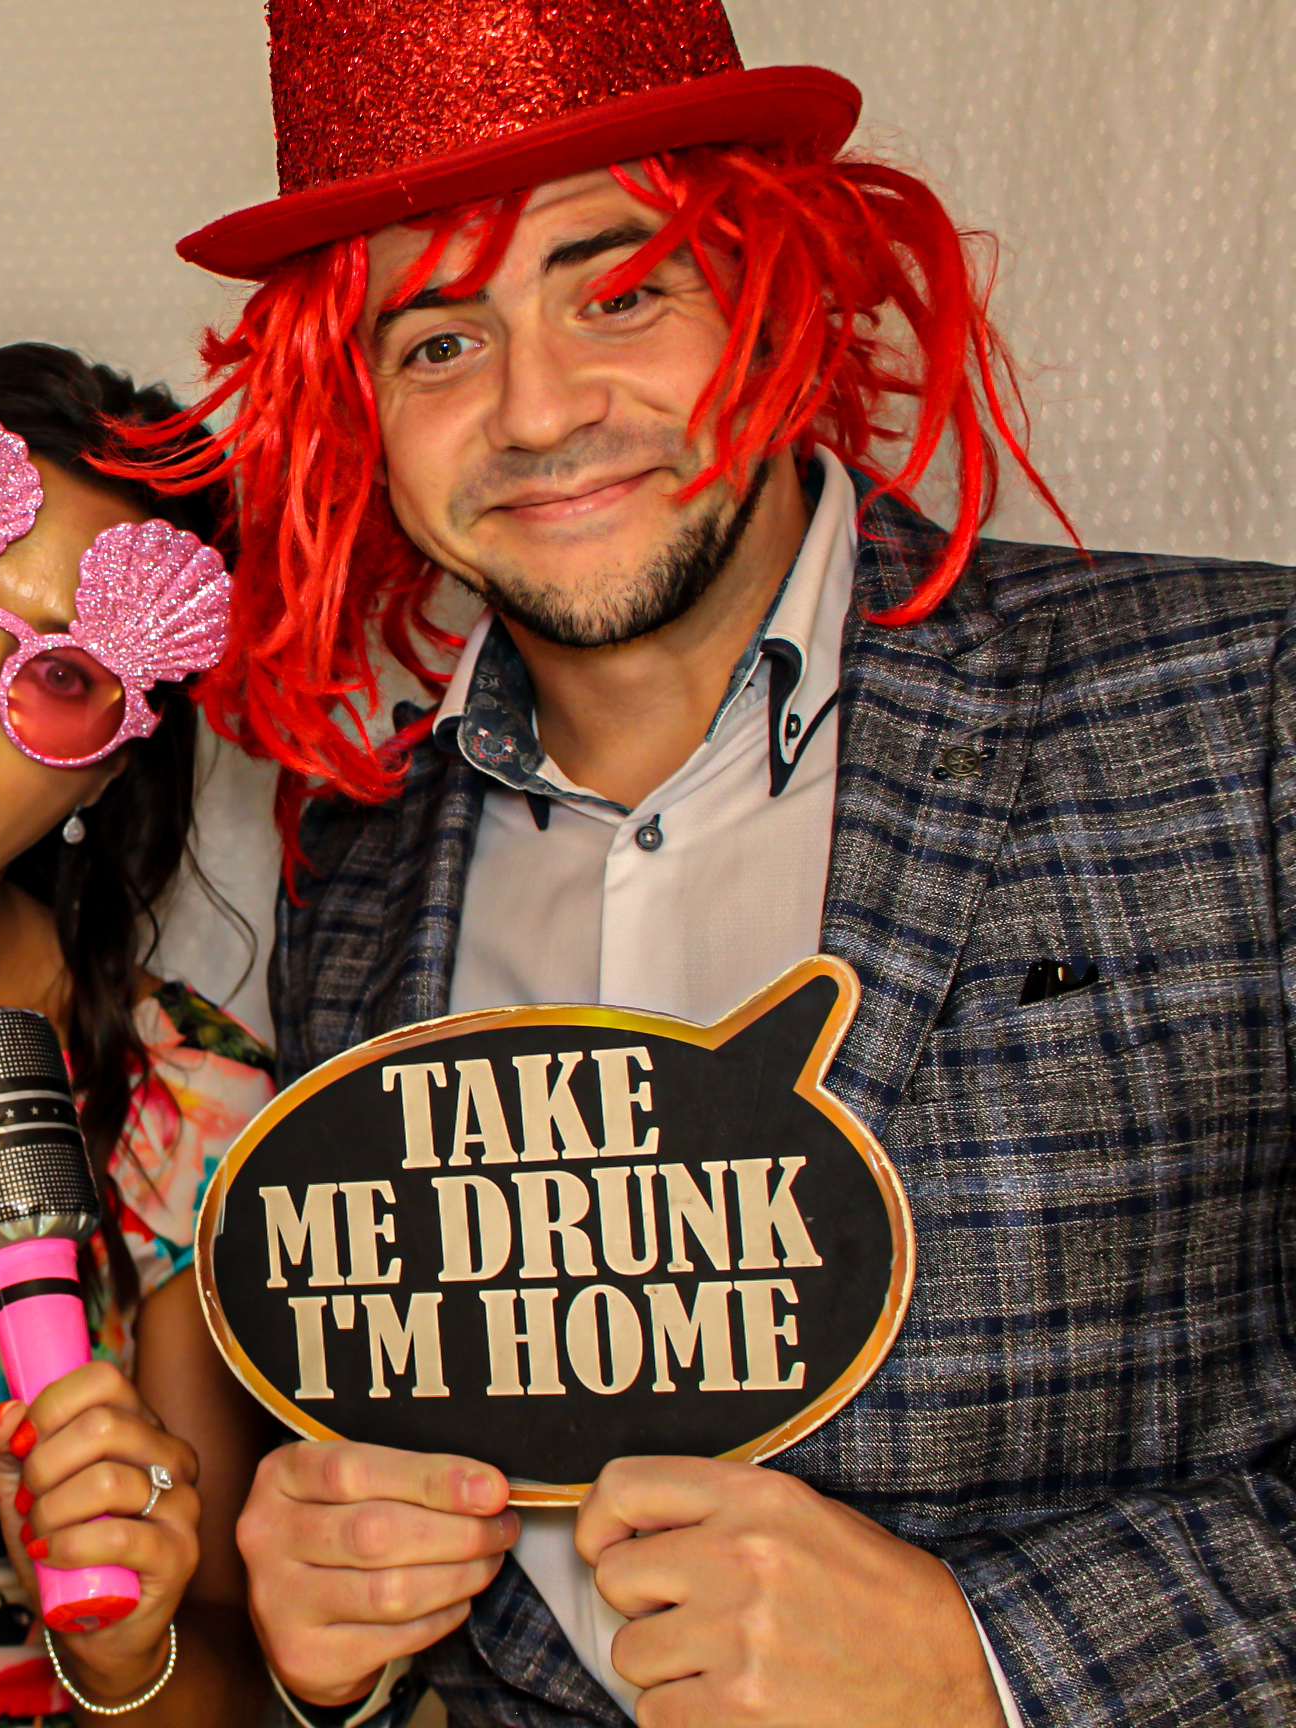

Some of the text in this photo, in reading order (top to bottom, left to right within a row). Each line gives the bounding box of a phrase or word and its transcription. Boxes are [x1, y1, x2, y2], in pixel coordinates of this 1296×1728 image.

[381, 1046, 661, 1169] TAKE
[259, 1156, 823, 1289] ME DRUNK
[288, 1278, 806, 1399] I'M HOME
